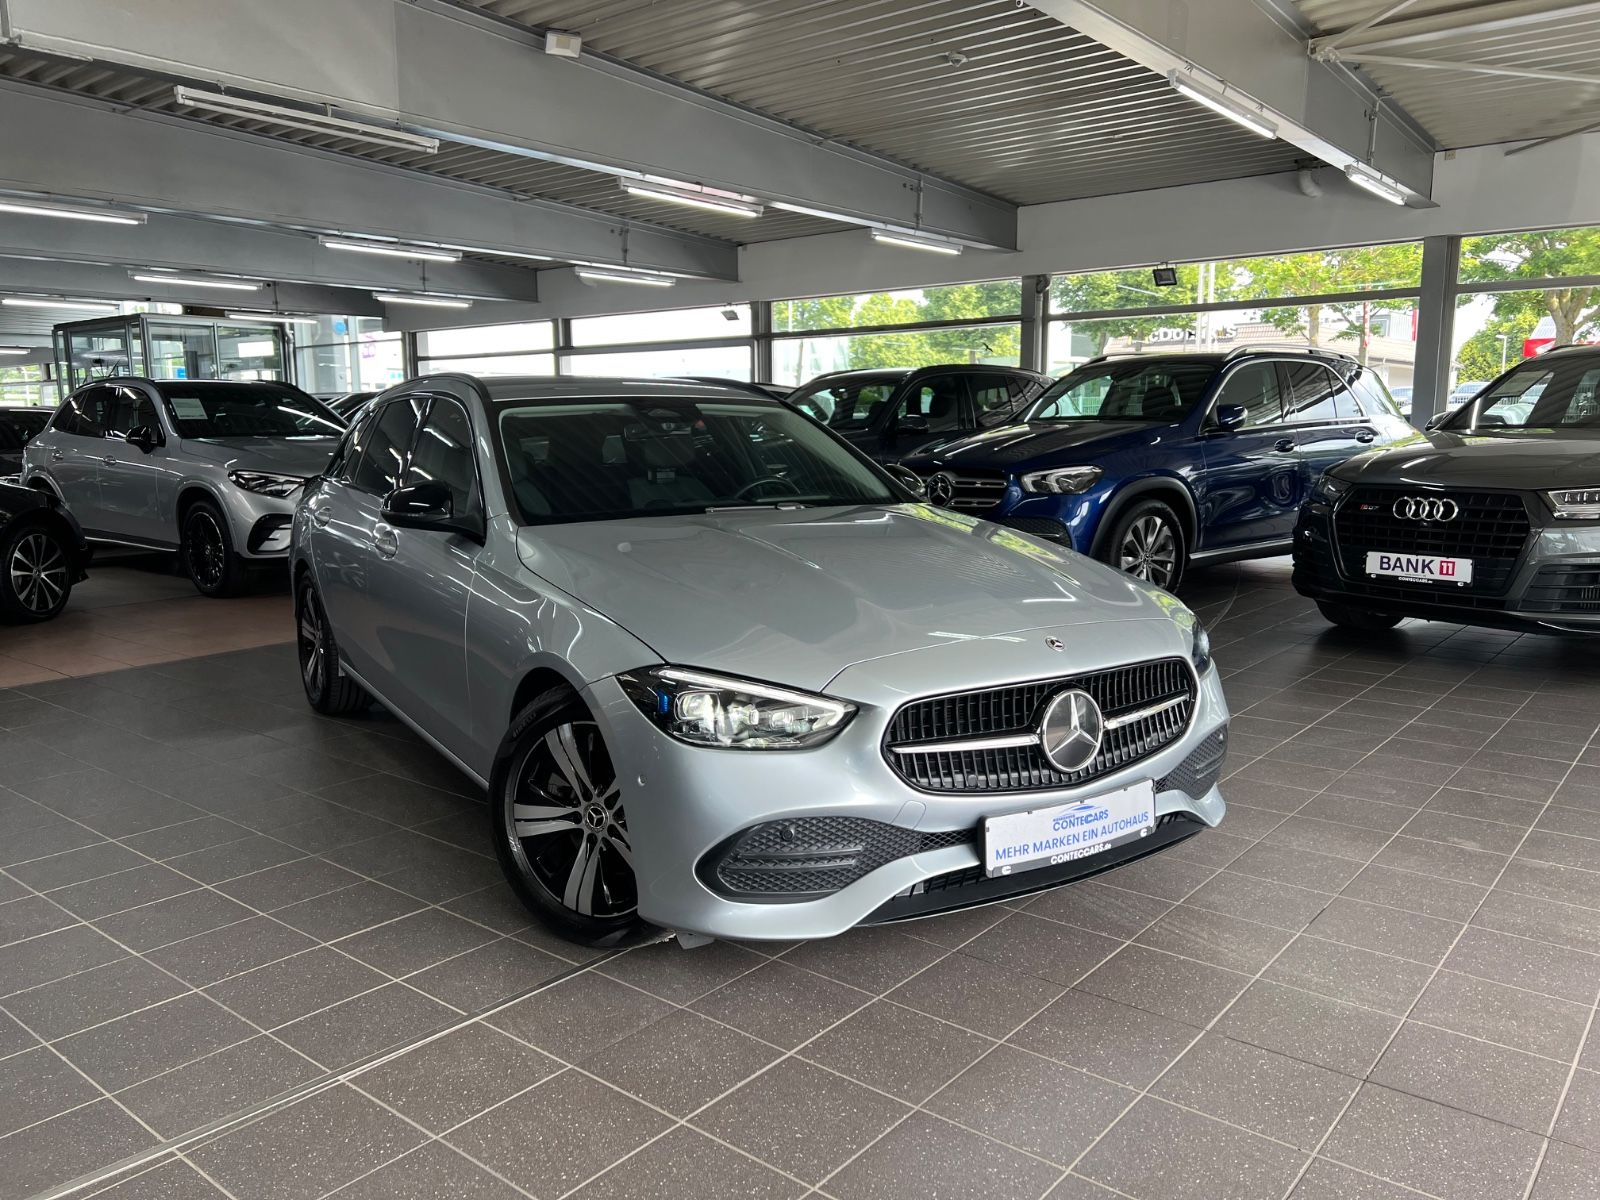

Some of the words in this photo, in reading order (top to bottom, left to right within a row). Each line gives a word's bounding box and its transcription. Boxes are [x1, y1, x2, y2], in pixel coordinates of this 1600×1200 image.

[1380, 556, 1434, 575] BANK
[1442, 562, 1453, 574] 11
[995, 843, 1030, 861] MEHR
[1033, 833, 1080, 853] MARKEN
[1082, 828, 1099, 842] EIN
[1101, 811, 1149, 836] AUTOHAUS
[1050, 843, 1112, 865] CONTECCARS.de
